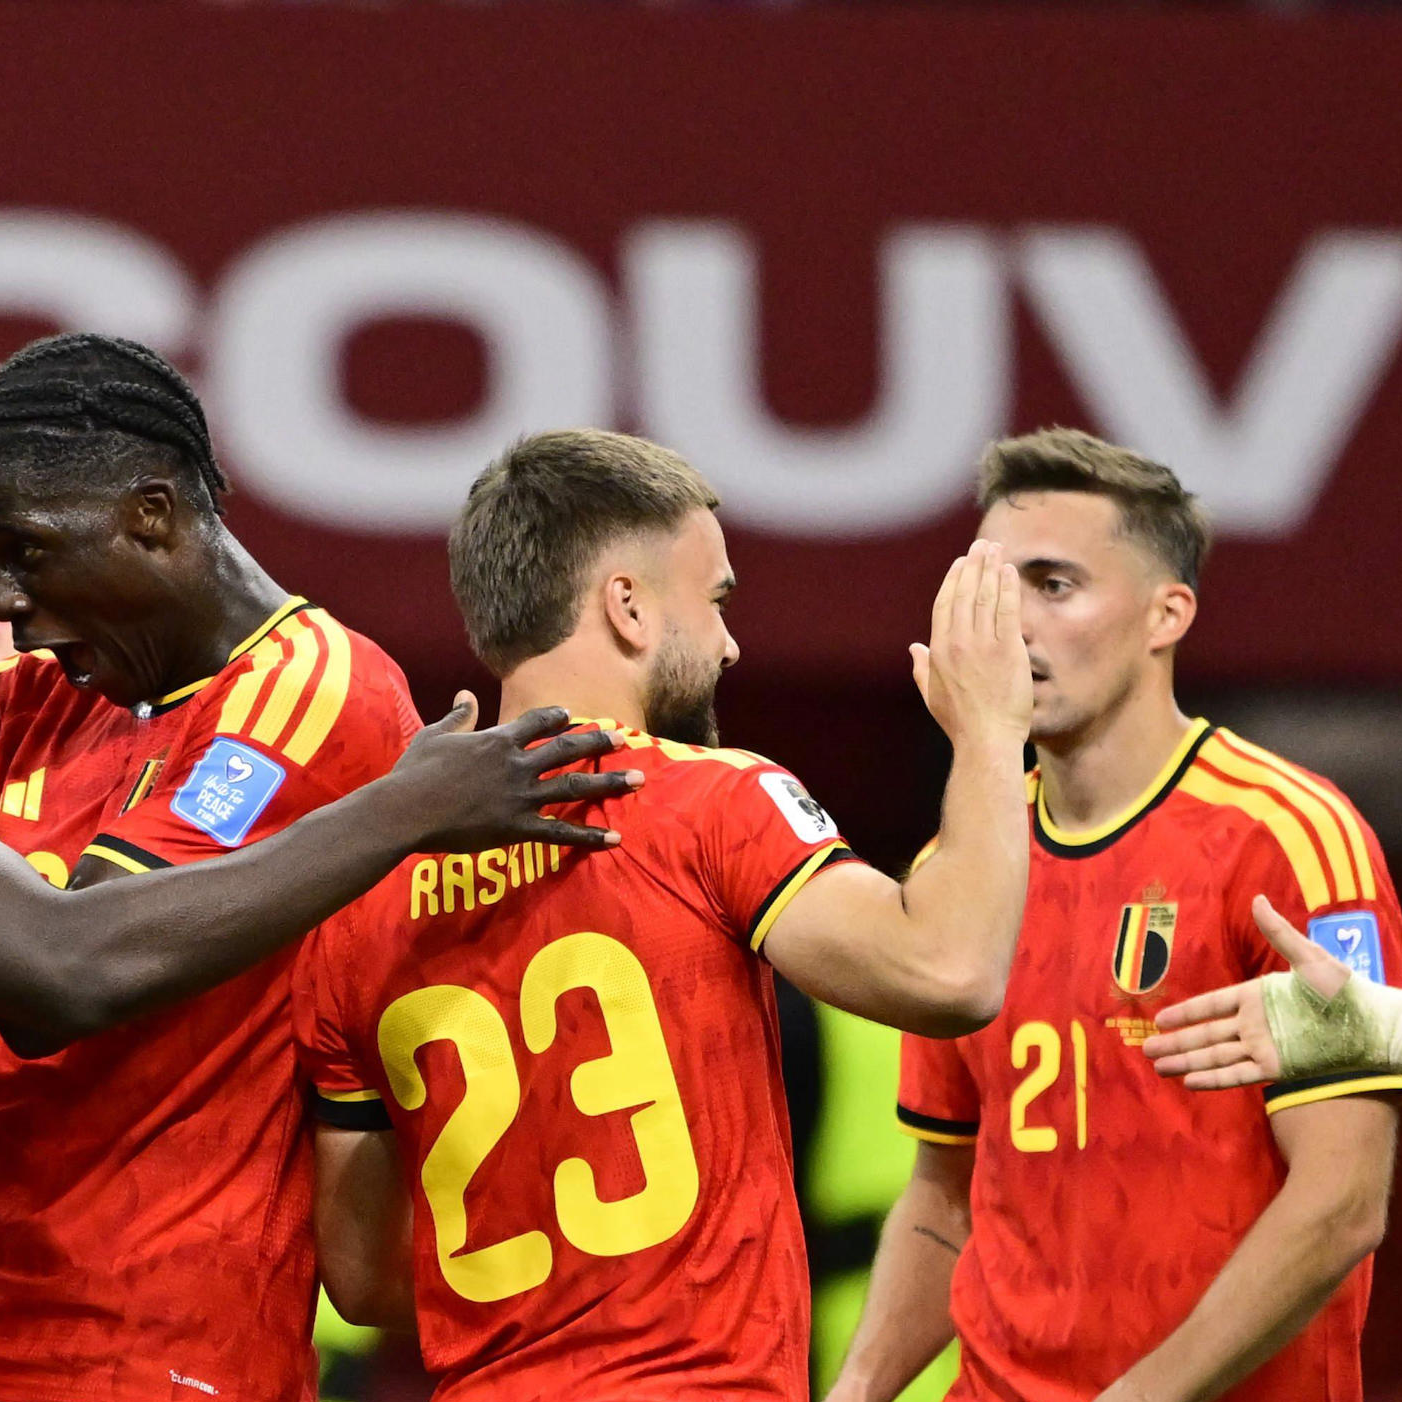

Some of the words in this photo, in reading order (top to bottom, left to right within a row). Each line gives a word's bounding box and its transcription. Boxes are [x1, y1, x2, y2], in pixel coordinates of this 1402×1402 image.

[196, 788, 236, 821] PEACE
[377, 932, 699, 1302] 23
[1010, 1019, 1087, 1153] 21
